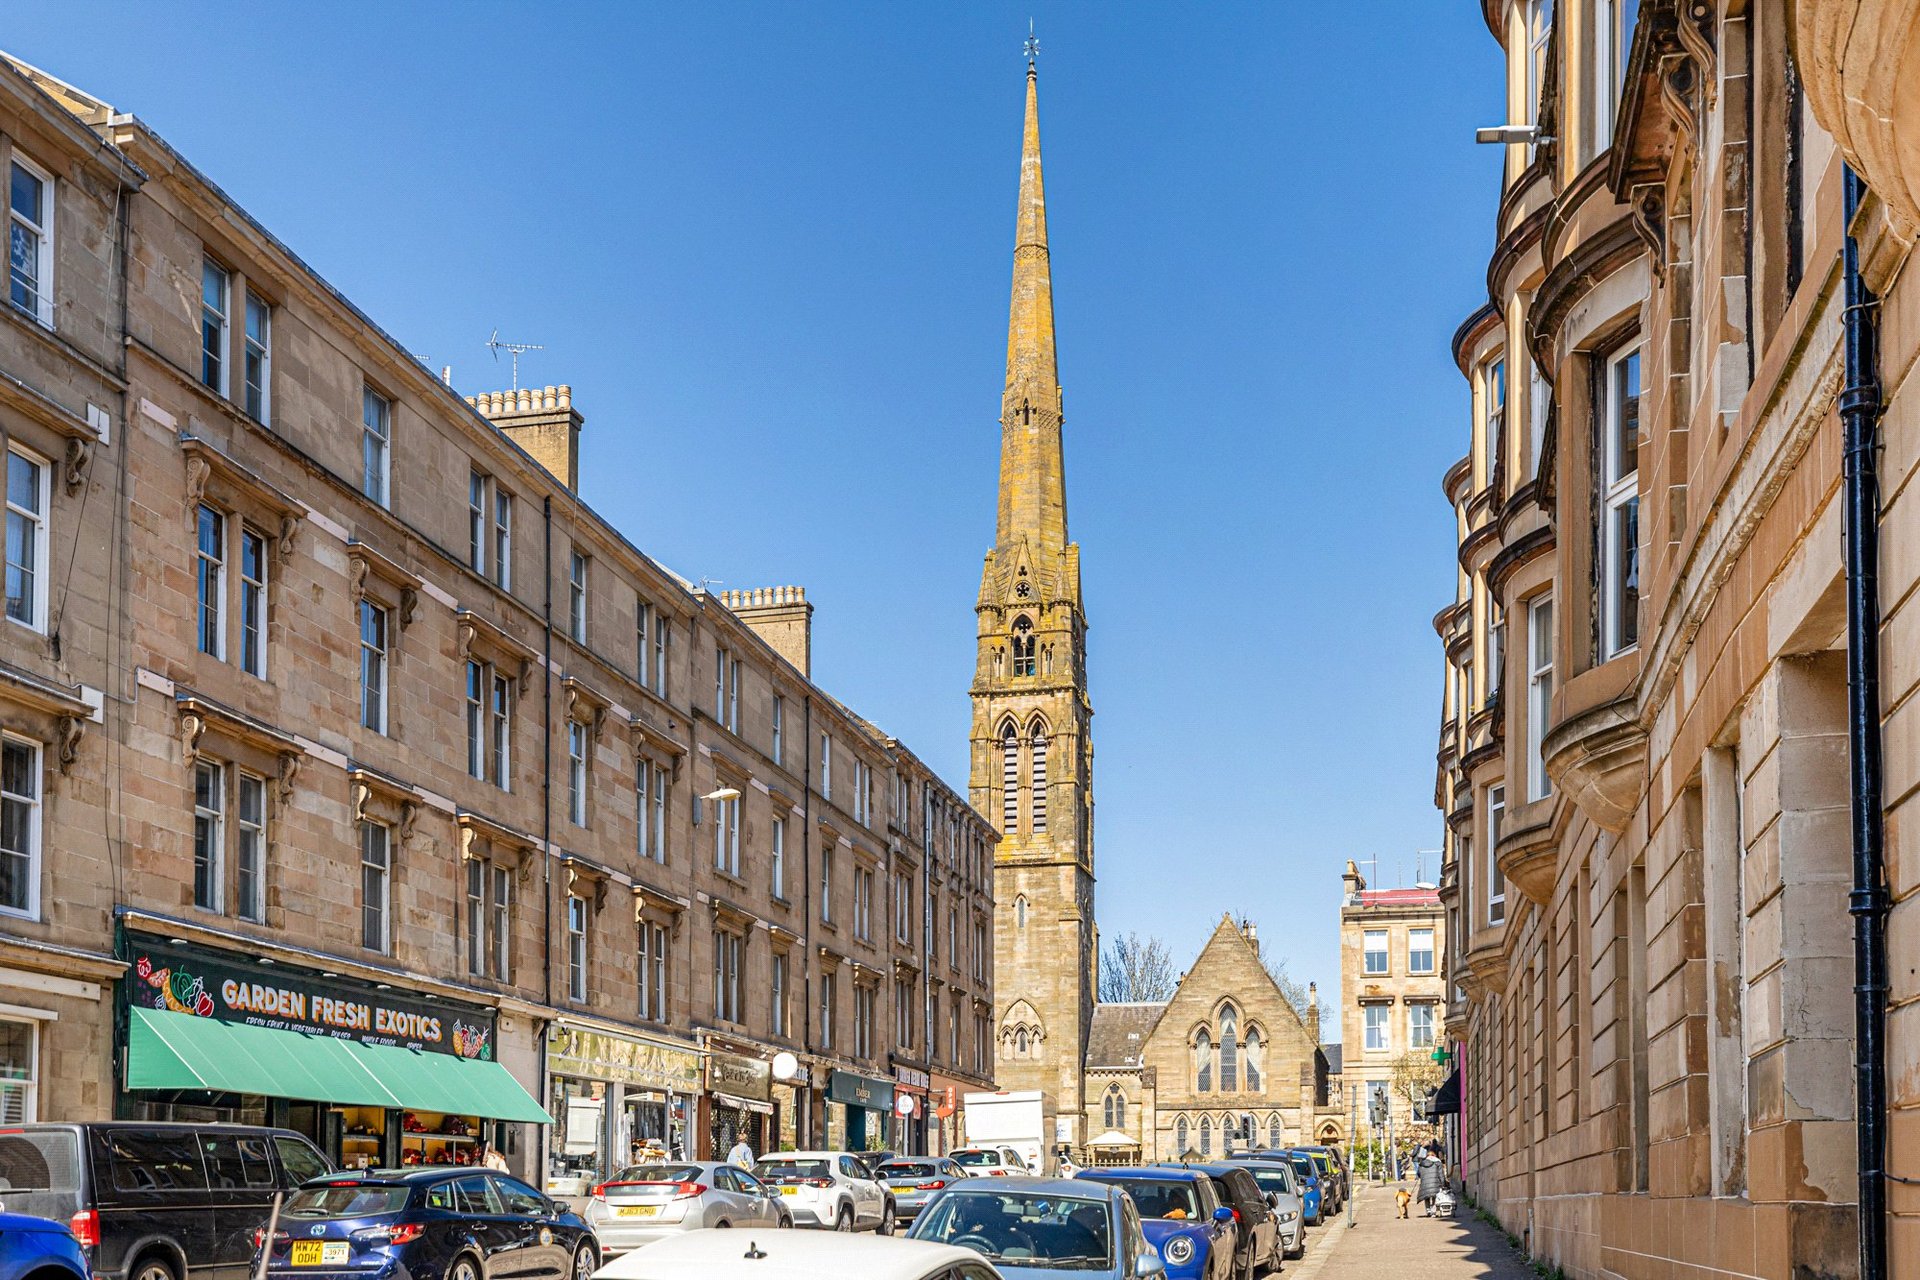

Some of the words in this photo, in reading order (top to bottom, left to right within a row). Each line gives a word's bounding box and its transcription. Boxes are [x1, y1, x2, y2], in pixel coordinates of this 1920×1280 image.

[222, 979, 306, 1020] GARDEN
[312, 996, 371, 1030] FRESH
[376, 1008, 442, 1042] EXOTICS
[856, 1087, 870, 1099] EMBER
[296, 1241, 321, 1252] MW72
